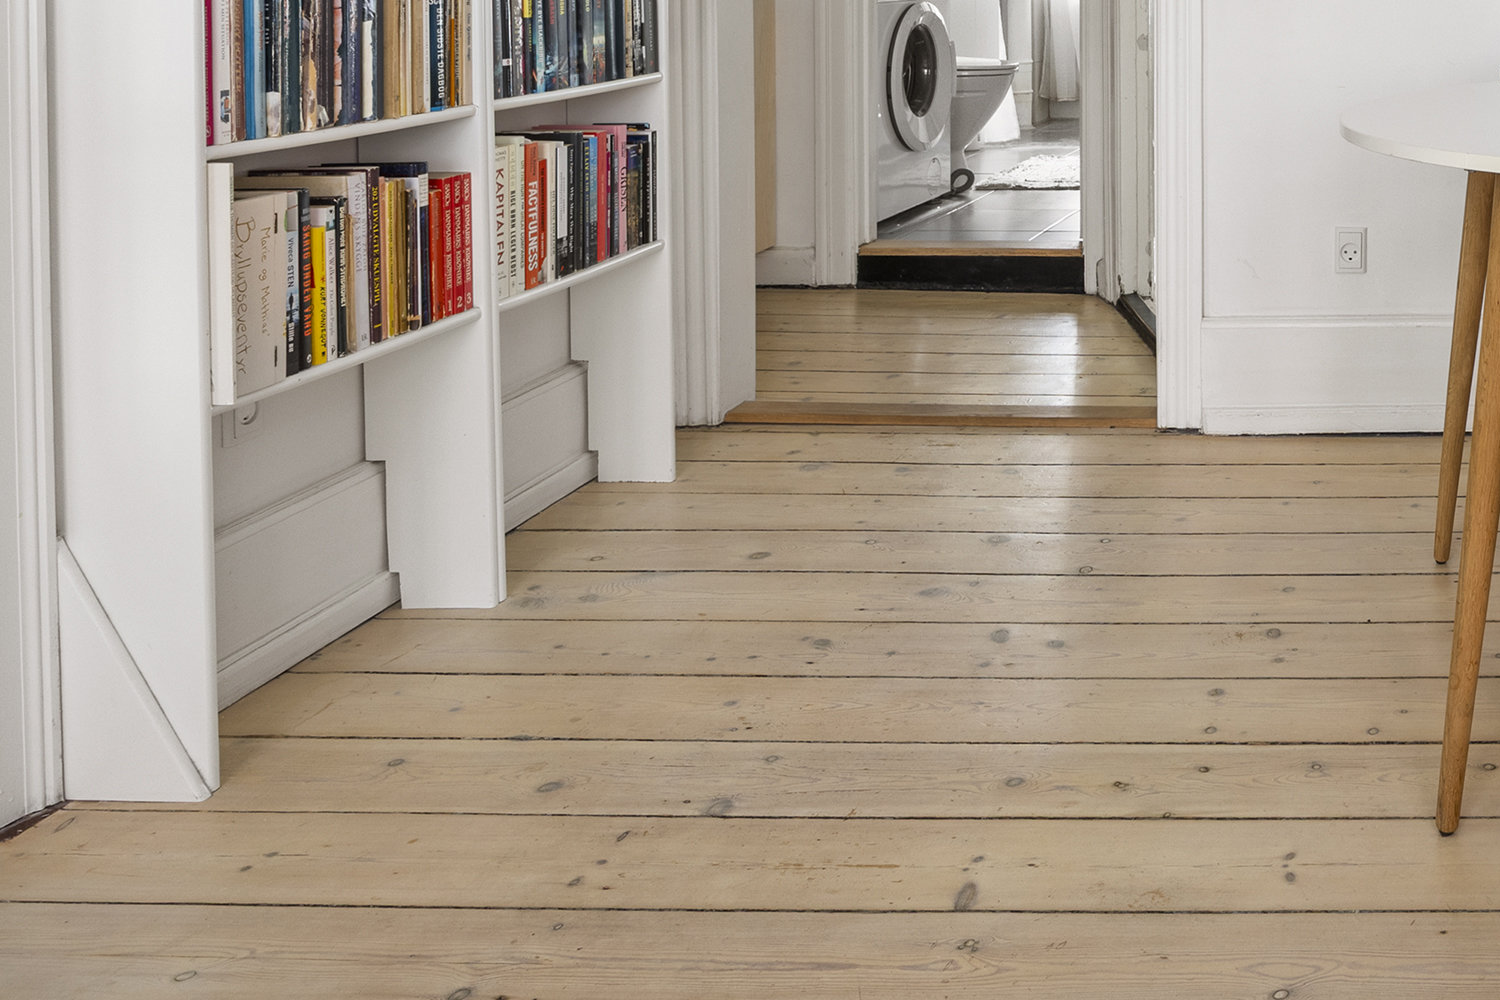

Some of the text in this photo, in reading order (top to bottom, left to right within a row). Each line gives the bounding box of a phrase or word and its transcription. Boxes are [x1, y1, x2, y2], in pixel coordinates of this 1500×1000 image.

[436, 8, 444, 28] DEN
[514, 6, 522, 55] SMITH
[260, 226, 272, 262] Marie
[372, 203, 380, 255] UDVALGTE
[528, 180, 538, 272] FACTFULNESS
[234, 216, 256, 375] Bryllupseventyr
[259, 268, 268, 281] og
[302, 225, 312, 337] SKRIG UNDER VAND
[457, 296, 463, 309] 2
[466, 292, 472, 304] 3
